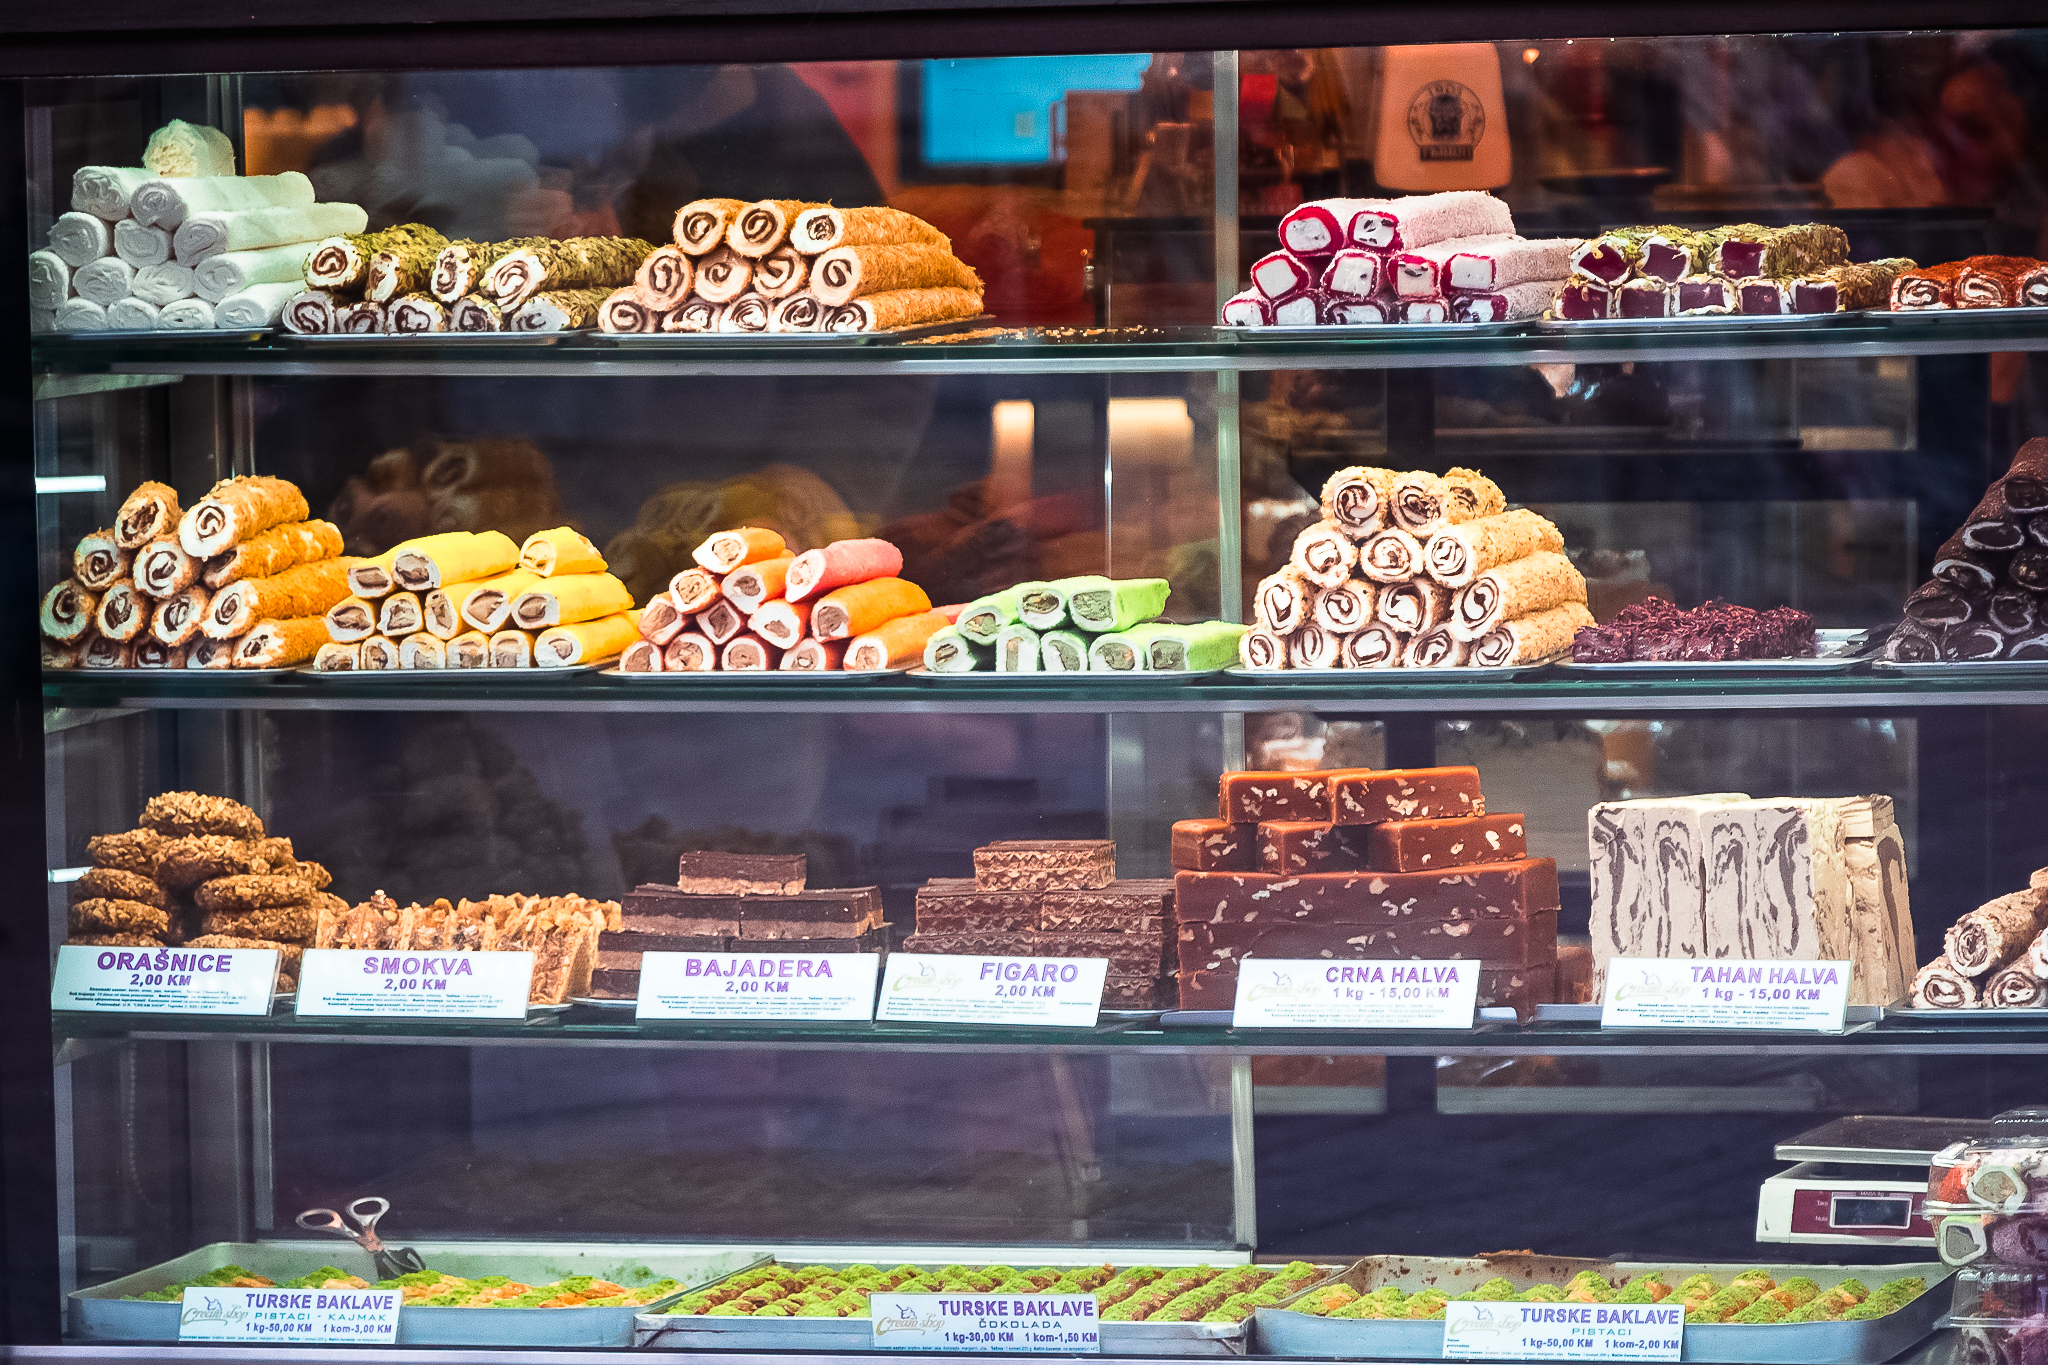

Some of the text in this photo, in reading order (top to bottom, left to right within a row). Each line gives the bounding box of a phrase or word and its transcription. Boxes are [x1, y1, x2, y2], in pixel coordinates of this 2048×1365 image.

[97, 947, 233, 973] ORAŠNICE
[363, 956, 473, 976] SMOKVA
[685, 958, 833, 978] BAJADERA
[979, 962, 1079, 983] FIGARO
[1325, 966, 1460, 984] CRNA HALVA
[1691, 966, 1838, 985] TAHAN HALVA
[130, 973, 192, 987] 2,00 KM
[384, 978, 447, 991] 2,00 KM
[725, 980, 789, 994] 2,00 KM
[995, 984, 1056, 998] 2,00 KM
[1332, 987, 1339, 999] 1
[1346, 987, 1364, 1000] kg
[1380, 987, 1421, 1000] 15,00
[1426, 987, 1450, 999] KM
[1702, 987, 1709, 999] 1
[1715, 987, 1734, 1001] kg
[1750, 988, 1791, 1001] 15,00
[1794, 989, 1820, 1000] KM
[245, 1293, 394, 1310] TURSKE BAKLAVE
[938, 1300, 1094, 1317] TURSKE BAKLAVE
[181, 1304, 248, 1325] Cream shop
[254, 1312, 311, 1320] PISTACI
[328, 1313, 387, 1321] KAJMAK
[1520, 1307, 1679, 1325] TURSKE BAKLAVE
[245, 1322, 392, 1335] 1 kg-50,00 KM 1 kom-3,00 KM
[875, 1312, 945, 1335] Cream shop
[978, 1317, 1062, 1329] ČOKOLADA
[1449, 1317, 1496, 1335] Cream
[944, 1332, 1098, 1344] 1 kg-30,00 KM 1 kom-1,50 KM
[1571, 1327, 1633, 1336] PISTACI
[1521, 1337, 1680, 1351] 1 kg-50,00 KM 1 kom-2,00 KM
